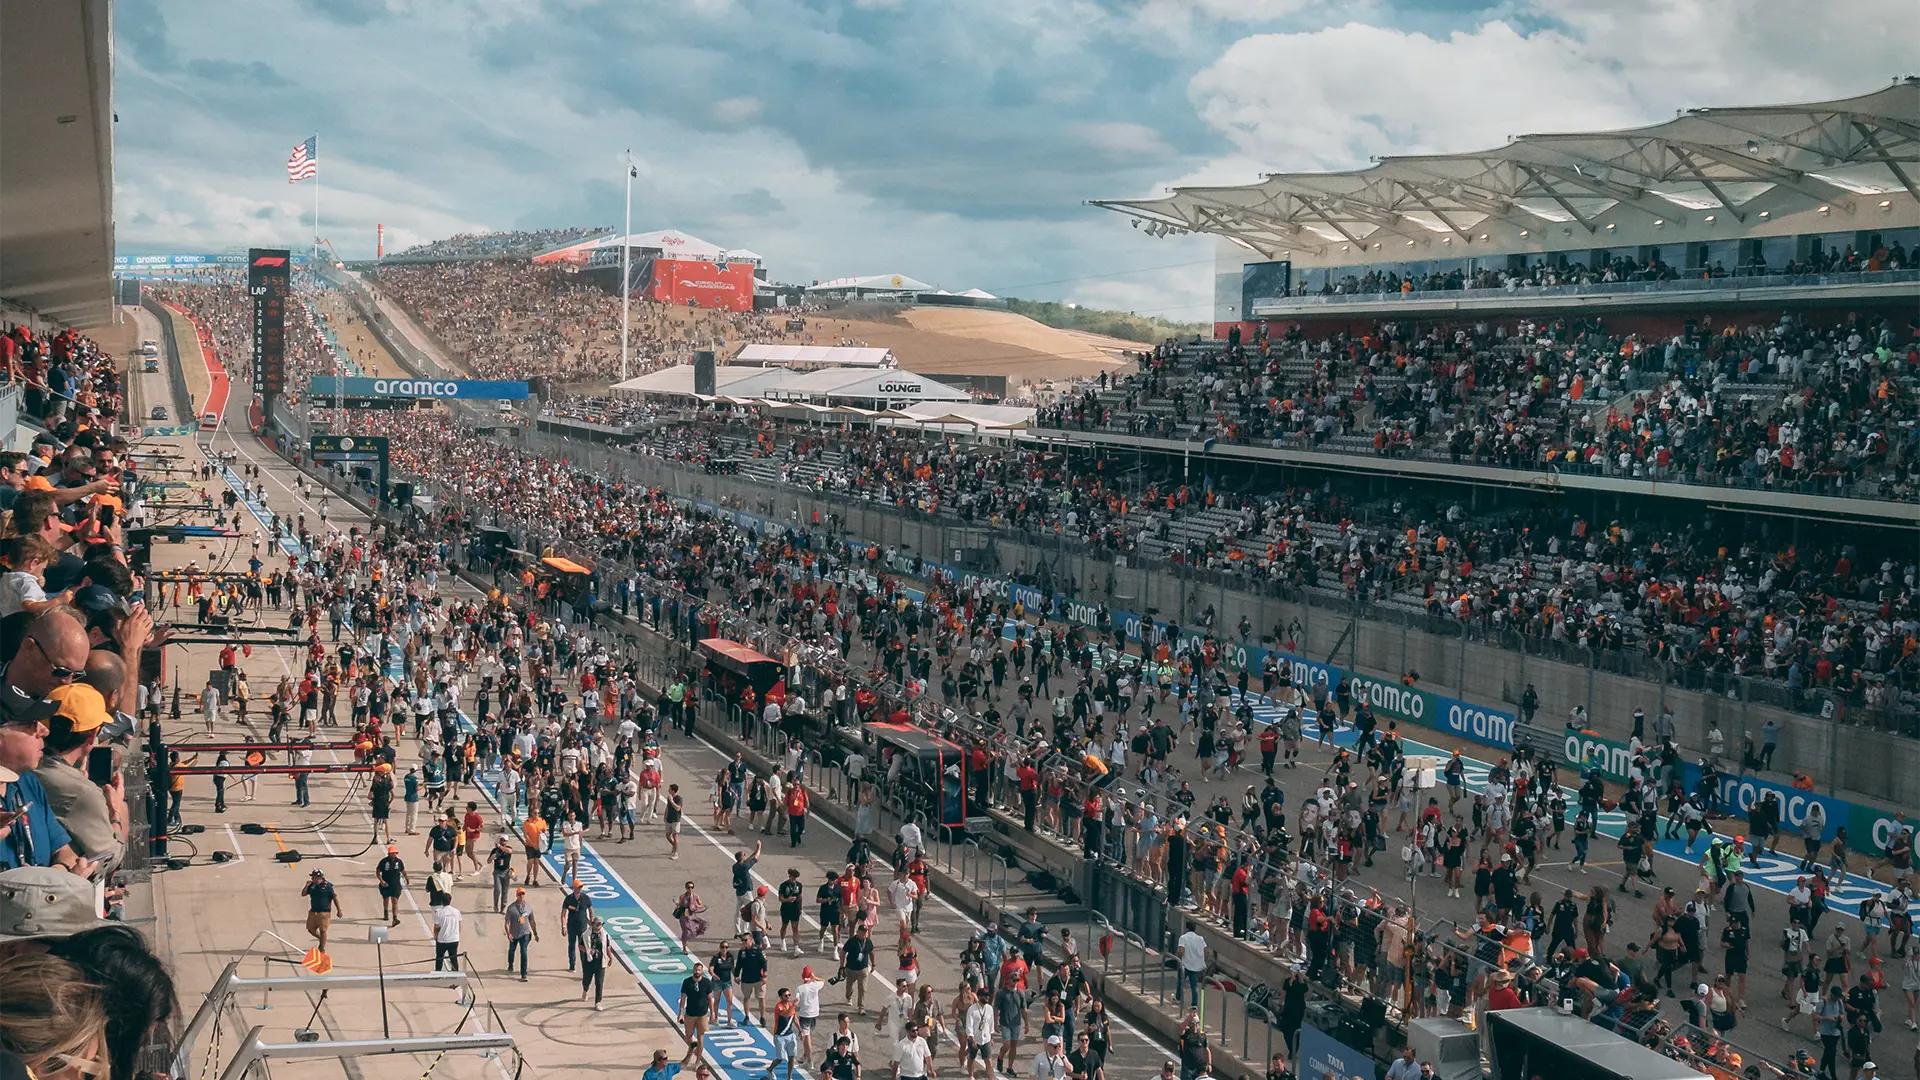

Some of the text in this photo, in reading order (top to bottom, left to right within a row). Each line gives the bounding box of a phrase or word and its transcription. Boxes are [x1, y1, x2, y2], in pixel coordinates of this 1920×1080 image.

[251, 286, 267, 295] LAP
[257, 373, 262, 381] 9
[374, 379, 458, 396] aramco
[879, 384, 921, 393] LOUNGE
[606, 916, 687, 973] aramco
[1327, 1053, 1345, 1072] TATA
